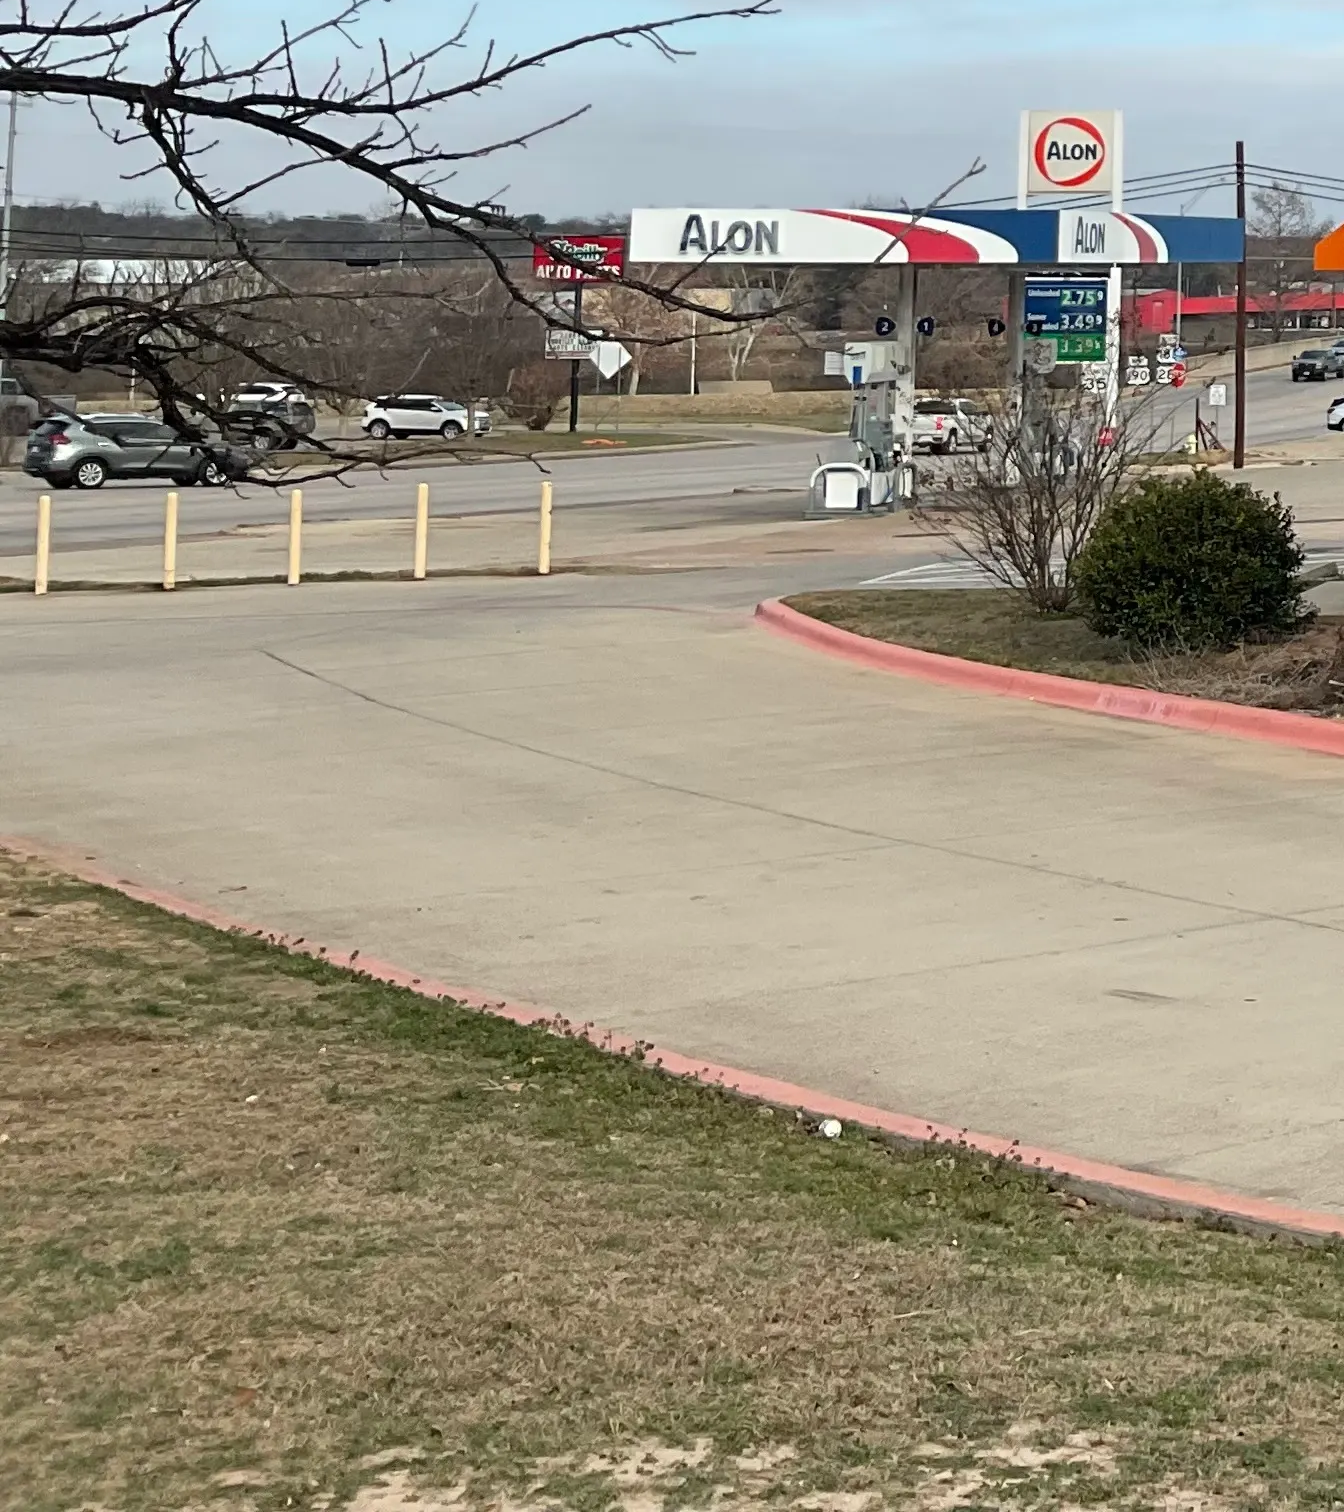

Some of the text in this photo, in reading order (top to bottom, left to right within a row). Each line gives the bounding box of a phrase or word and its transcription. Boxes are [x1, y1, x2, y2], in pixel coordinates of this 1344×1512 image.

[1047, 140, 1098, 161] ALON
[679, 213, 780, 254] ALON
[1075, 216, 1106, 254] ALON
[881, 322, 889, 333] 2
